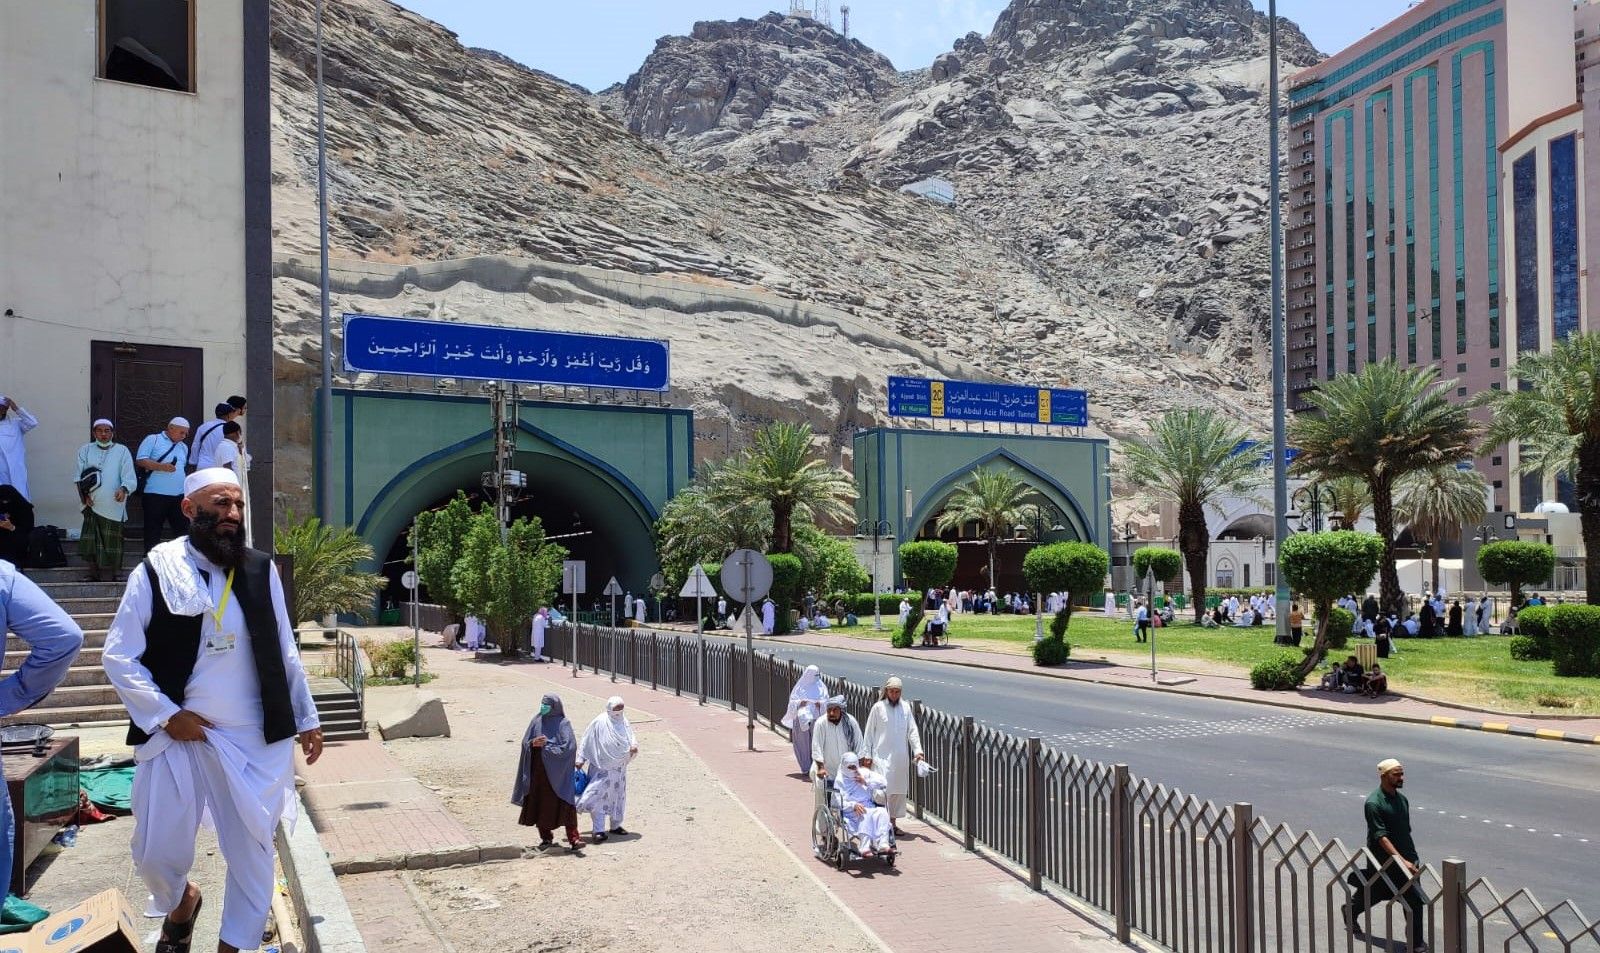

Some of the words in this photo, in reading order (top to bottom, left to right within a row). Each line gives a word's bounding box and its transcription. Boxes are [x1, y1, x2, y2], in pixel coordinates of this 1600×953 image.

[933, 389, 942, 401] 2C
[982, 391, 999, 403] الملك
[1000, 393, 1020, 408] طريق
[947, 406, 962, 415] King
[963, 408, 982, 416] Abdul
[984, 409, 997, 417] Aziz
[999, 410, 1016, 418] Road
[1018, 411, 1037, 419] Tunnel
